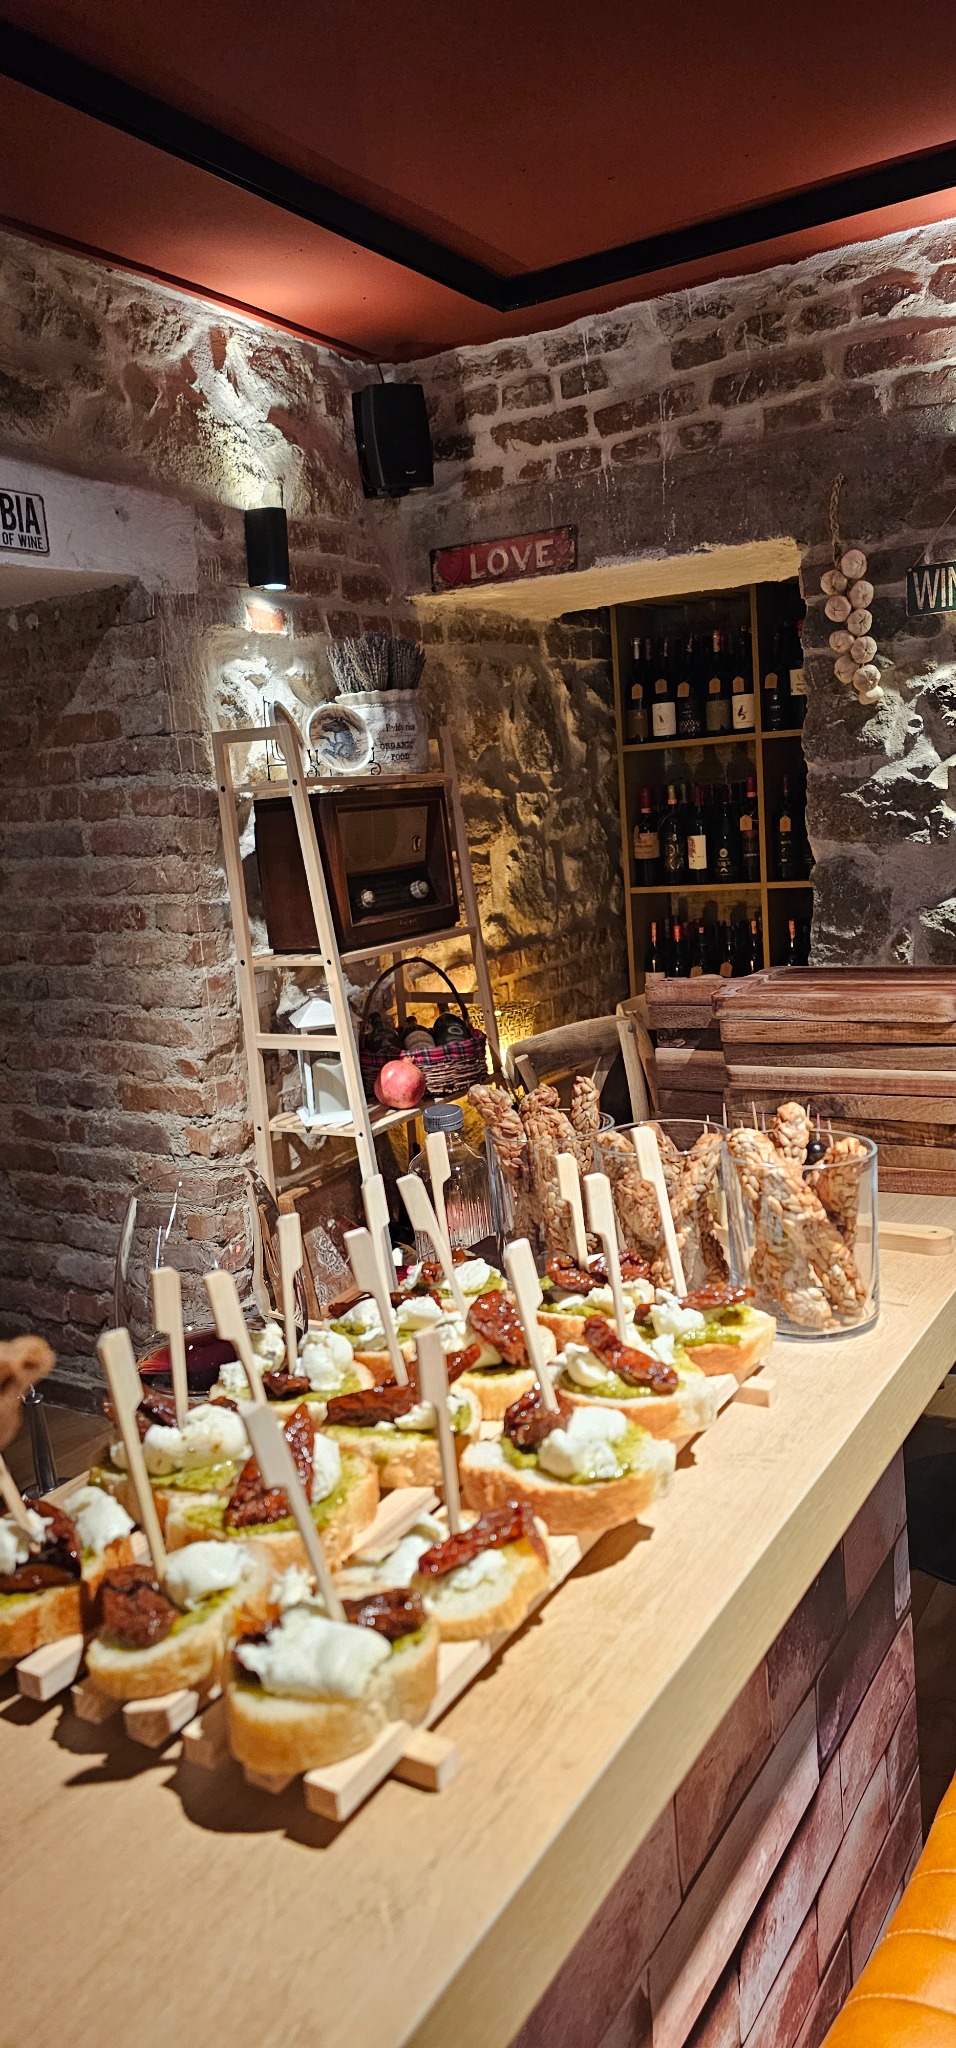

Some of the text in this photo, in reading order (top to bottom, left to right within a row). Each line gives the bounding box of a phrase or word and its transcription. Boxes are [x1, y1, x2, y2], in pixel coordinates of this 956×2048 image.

[2, 532, 43, 550] OF WINE
[470, 539, 553, 579] LOVE
[380, 740, 414, 750] ORGANIC
[391, 753, 409, 761] FOOD
